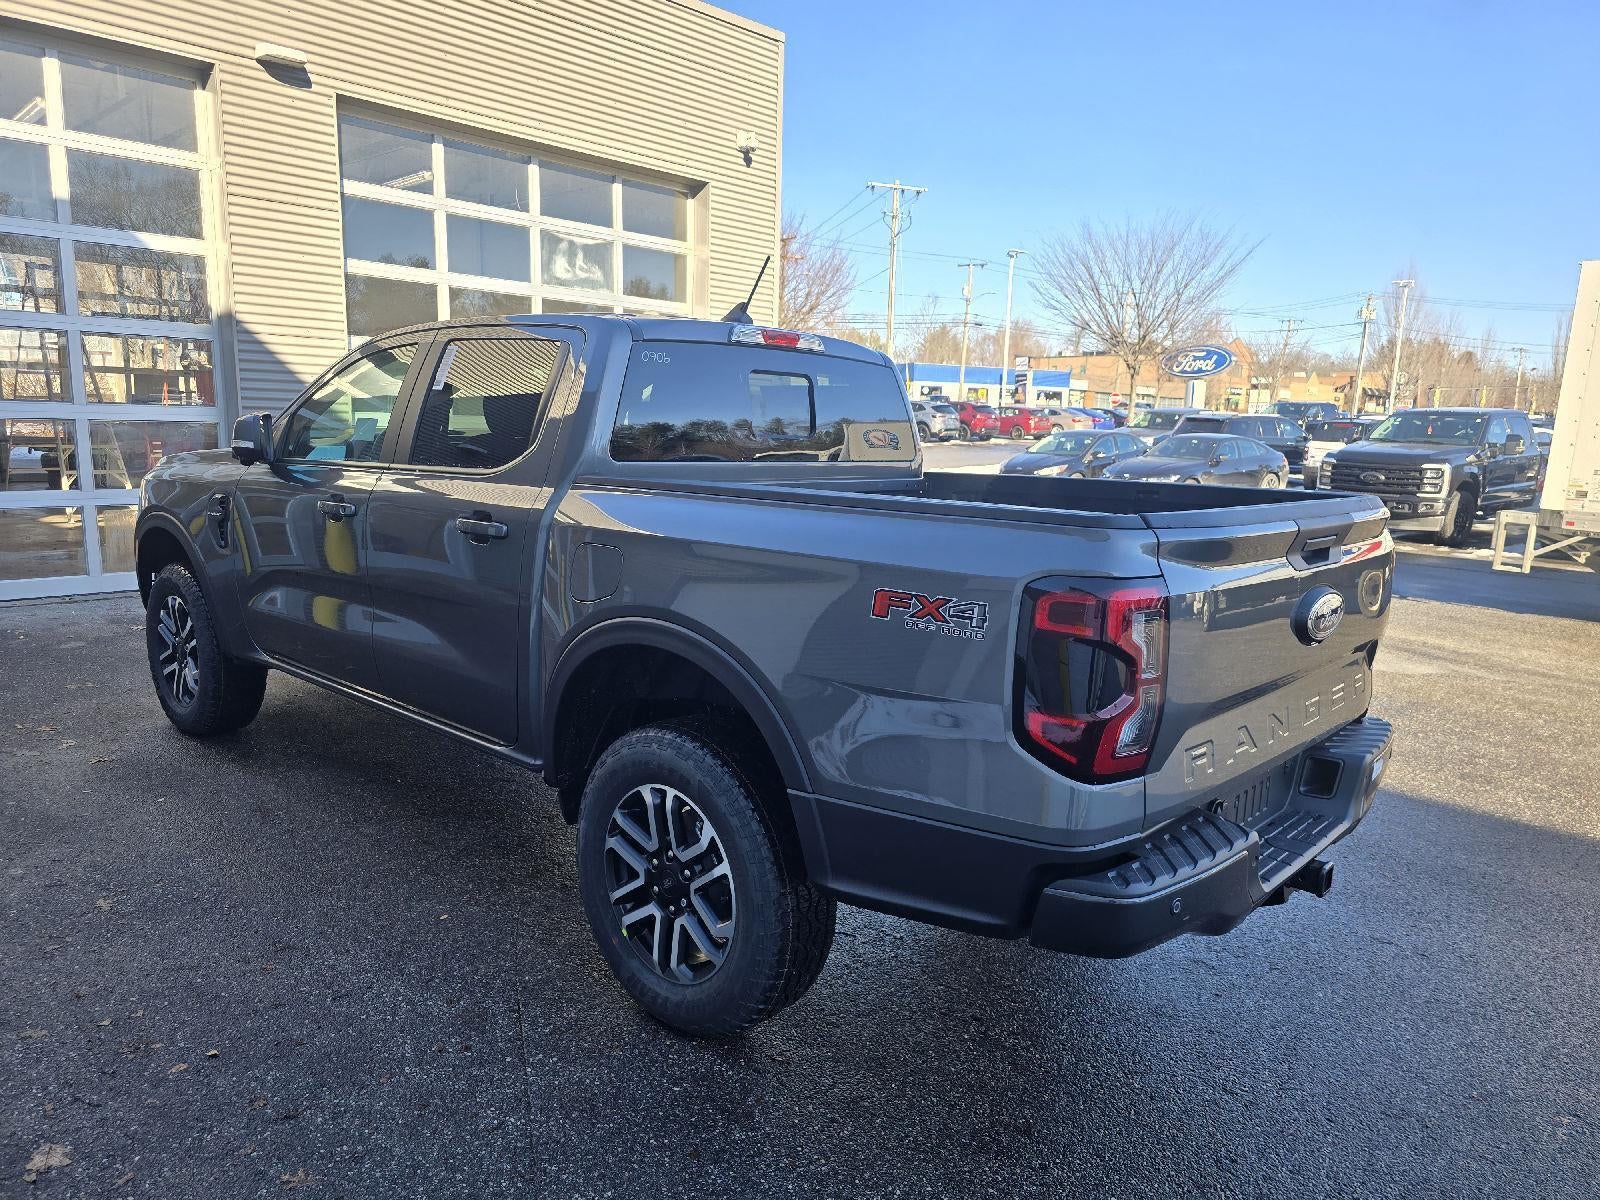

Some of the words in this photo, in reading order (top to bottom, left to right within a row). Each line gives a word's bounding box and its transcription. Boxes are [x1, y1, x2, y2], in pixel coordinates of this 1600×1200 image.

[1172, 351, 1218, 373] Ford
[870, 587, 989, 631] FX4
[904, 619, 936, 632] OFF
[940, 626, 986, 641] ROAD
[1184, 670, 1366, 784] RANGER
